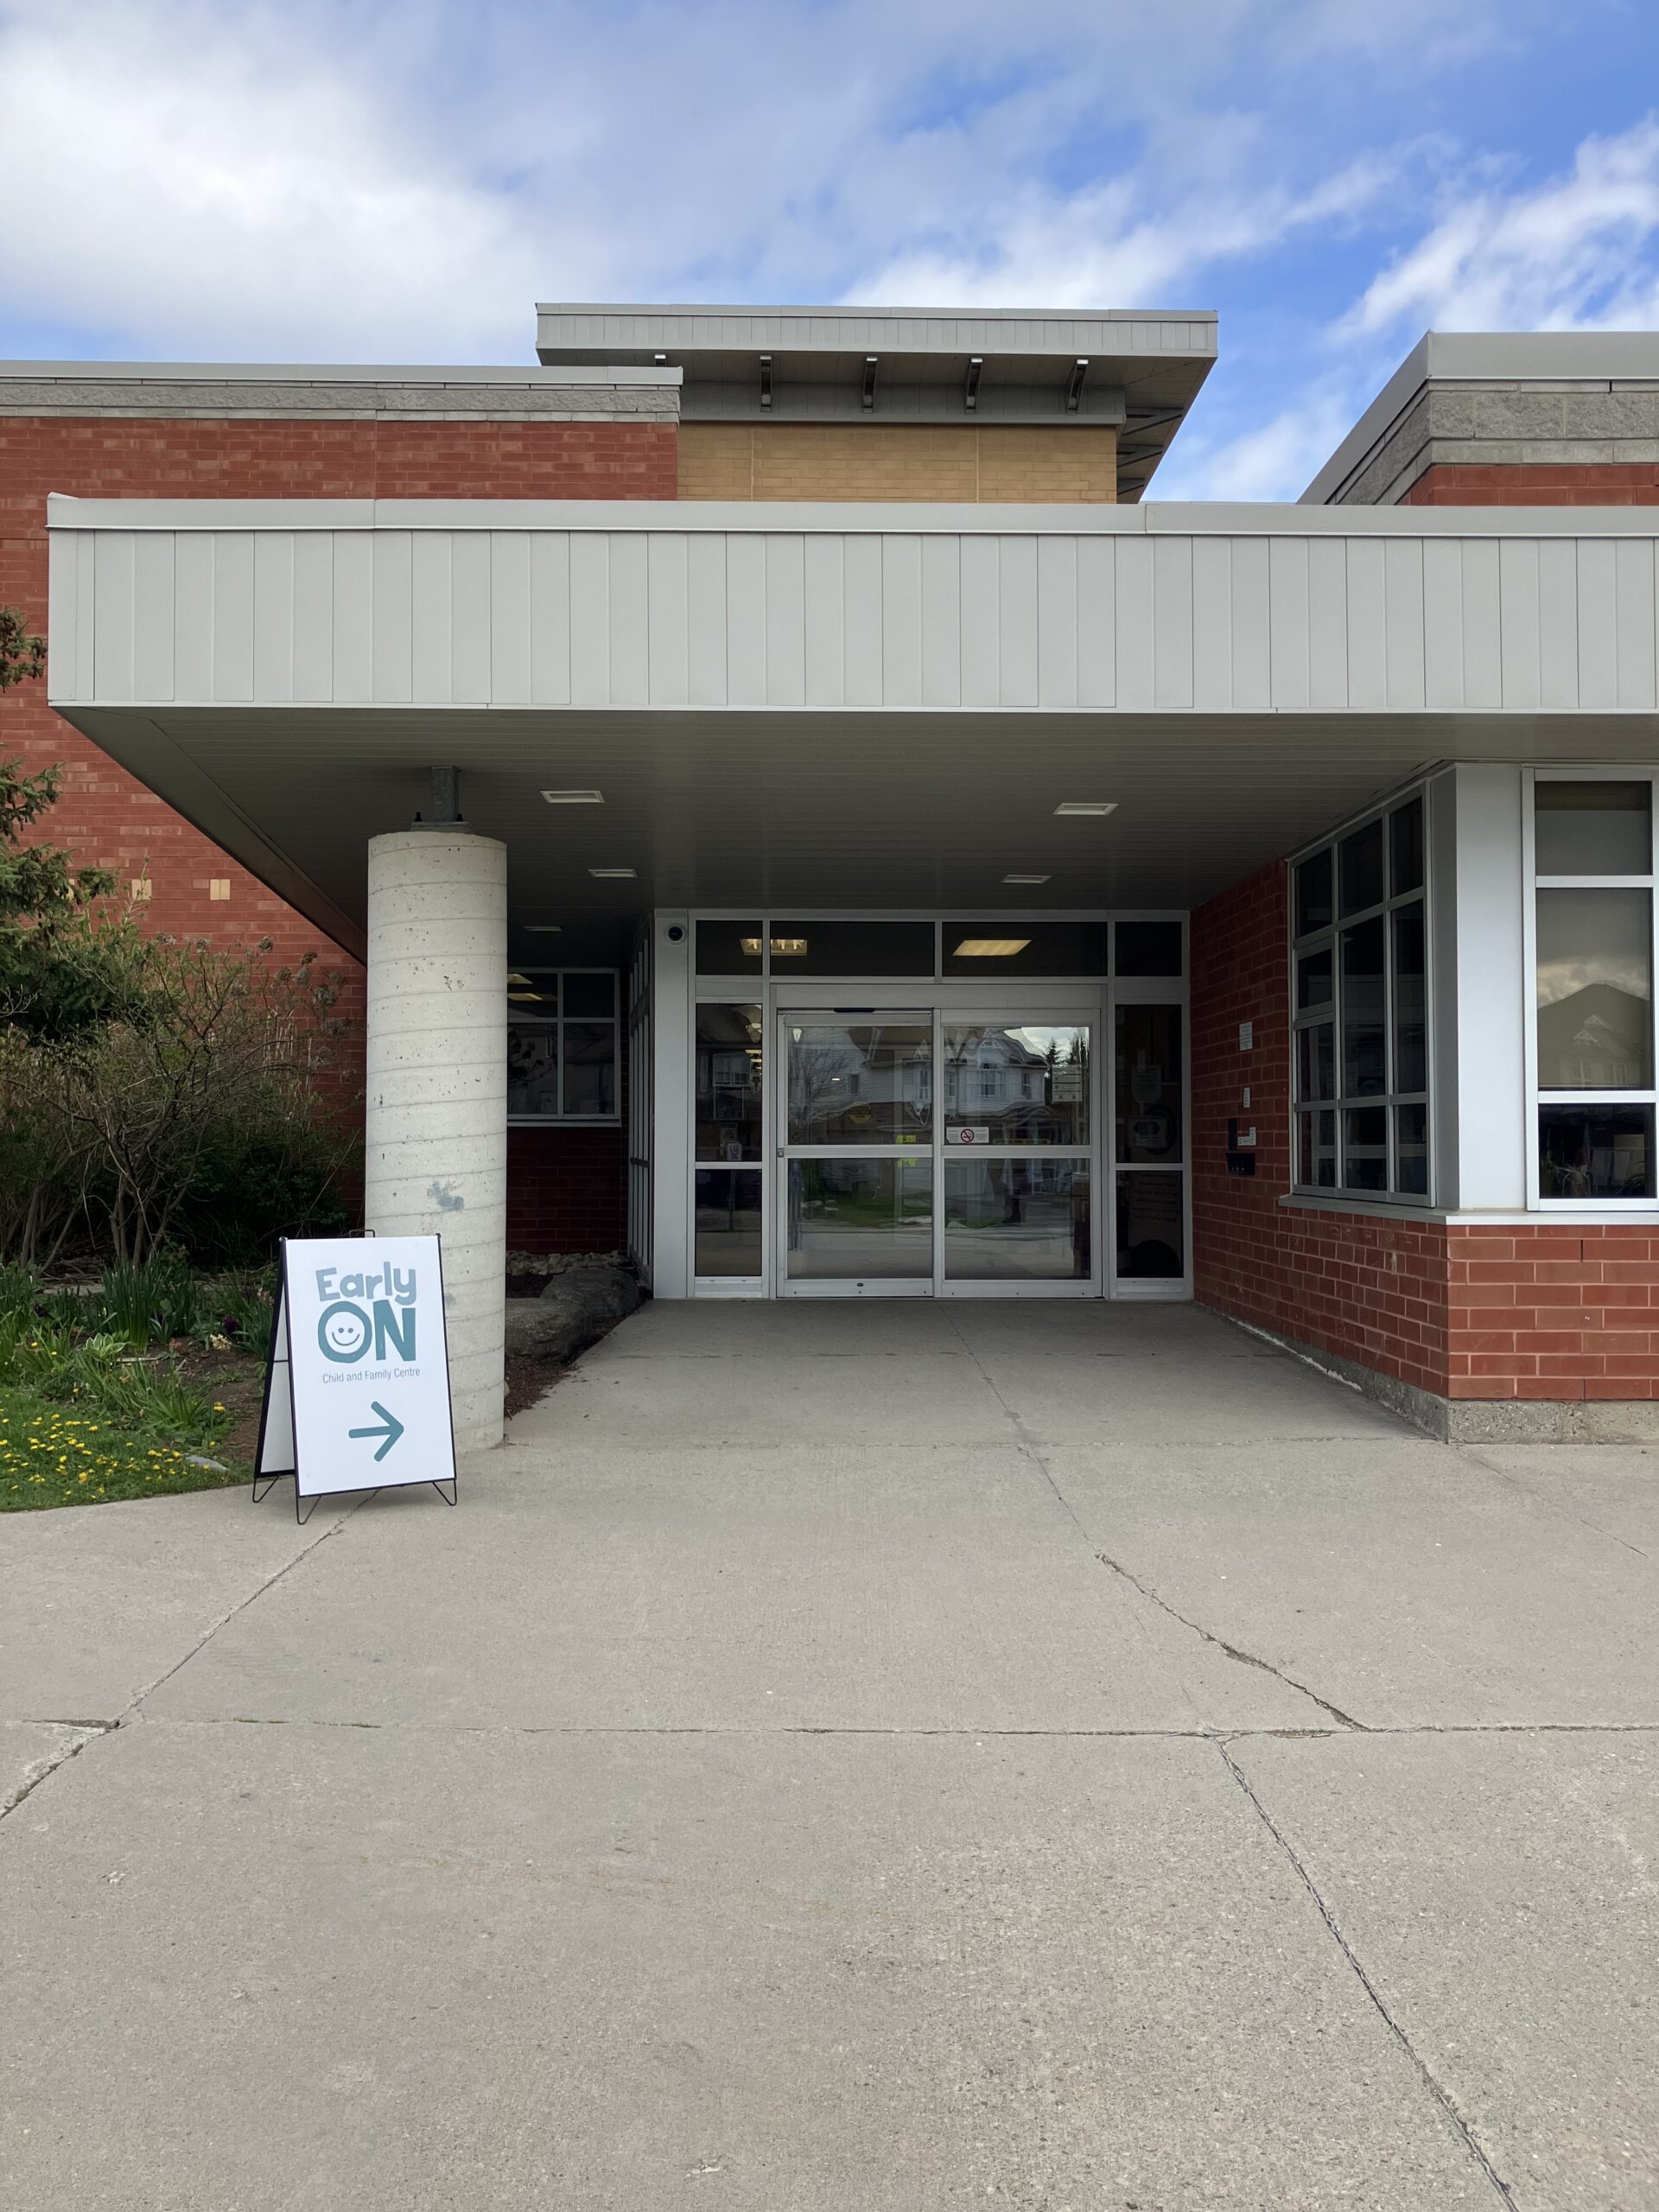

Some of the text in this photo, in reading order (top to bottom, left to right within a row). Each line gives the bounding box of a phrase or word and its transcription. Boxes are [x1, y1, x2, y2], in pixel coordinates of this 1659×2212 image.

[315, 1262, 416, 1306] Early
[318, 1300, 416, 1363] ON
[322, 1368, 421, 1383] Child and Family Centre
